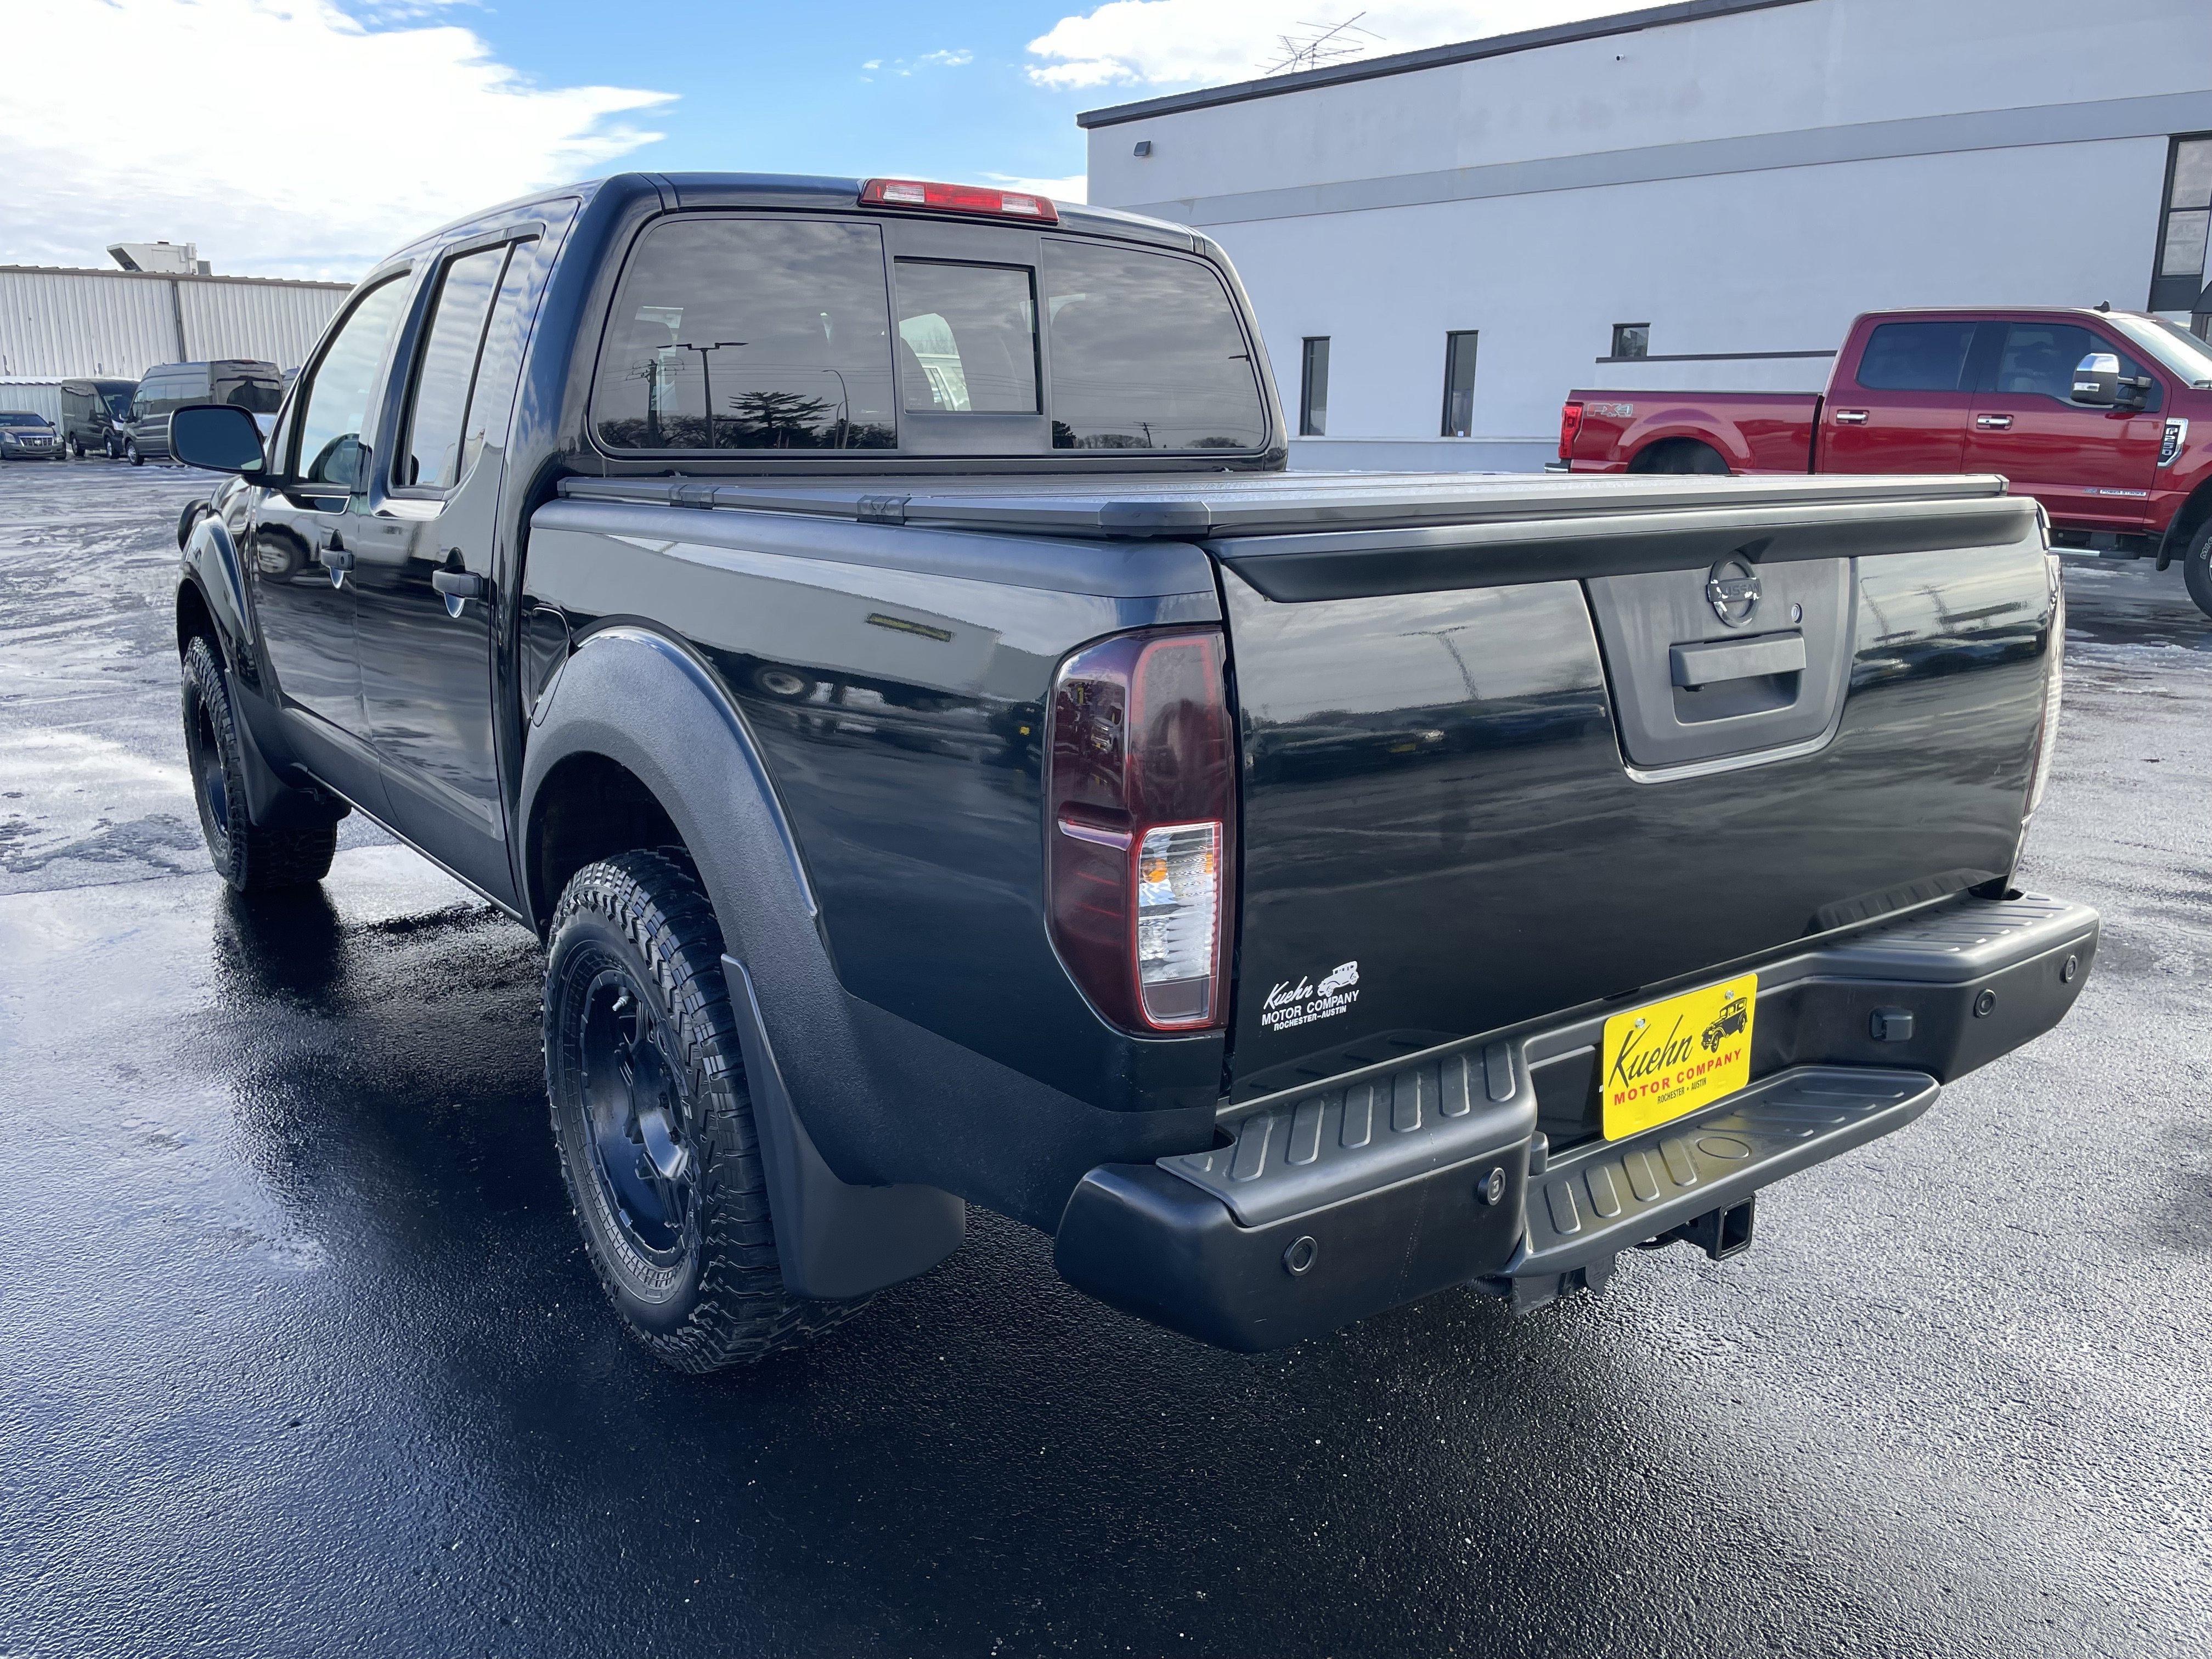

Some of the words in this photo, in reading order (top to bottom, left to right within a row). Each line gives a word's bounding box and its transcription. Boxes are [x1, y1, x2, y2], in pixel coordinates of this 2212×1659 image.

[1262, 1005, 1302, 1026] MOTOR
[1307, 990, 1359, 1013] COMPANY
[1263, 976, 1313, 1009] Kuehn
[1609, 1014, 1693, 1088] Kuehn
[1614, 1077, 1670, 1106] MOTOR
[1677, 1048, 1741, 1084] COMPANY
[1657, 1088, 1685, 1104] ROCHESTER
[1691, 1077, 1707, 1091] AUSTIN
